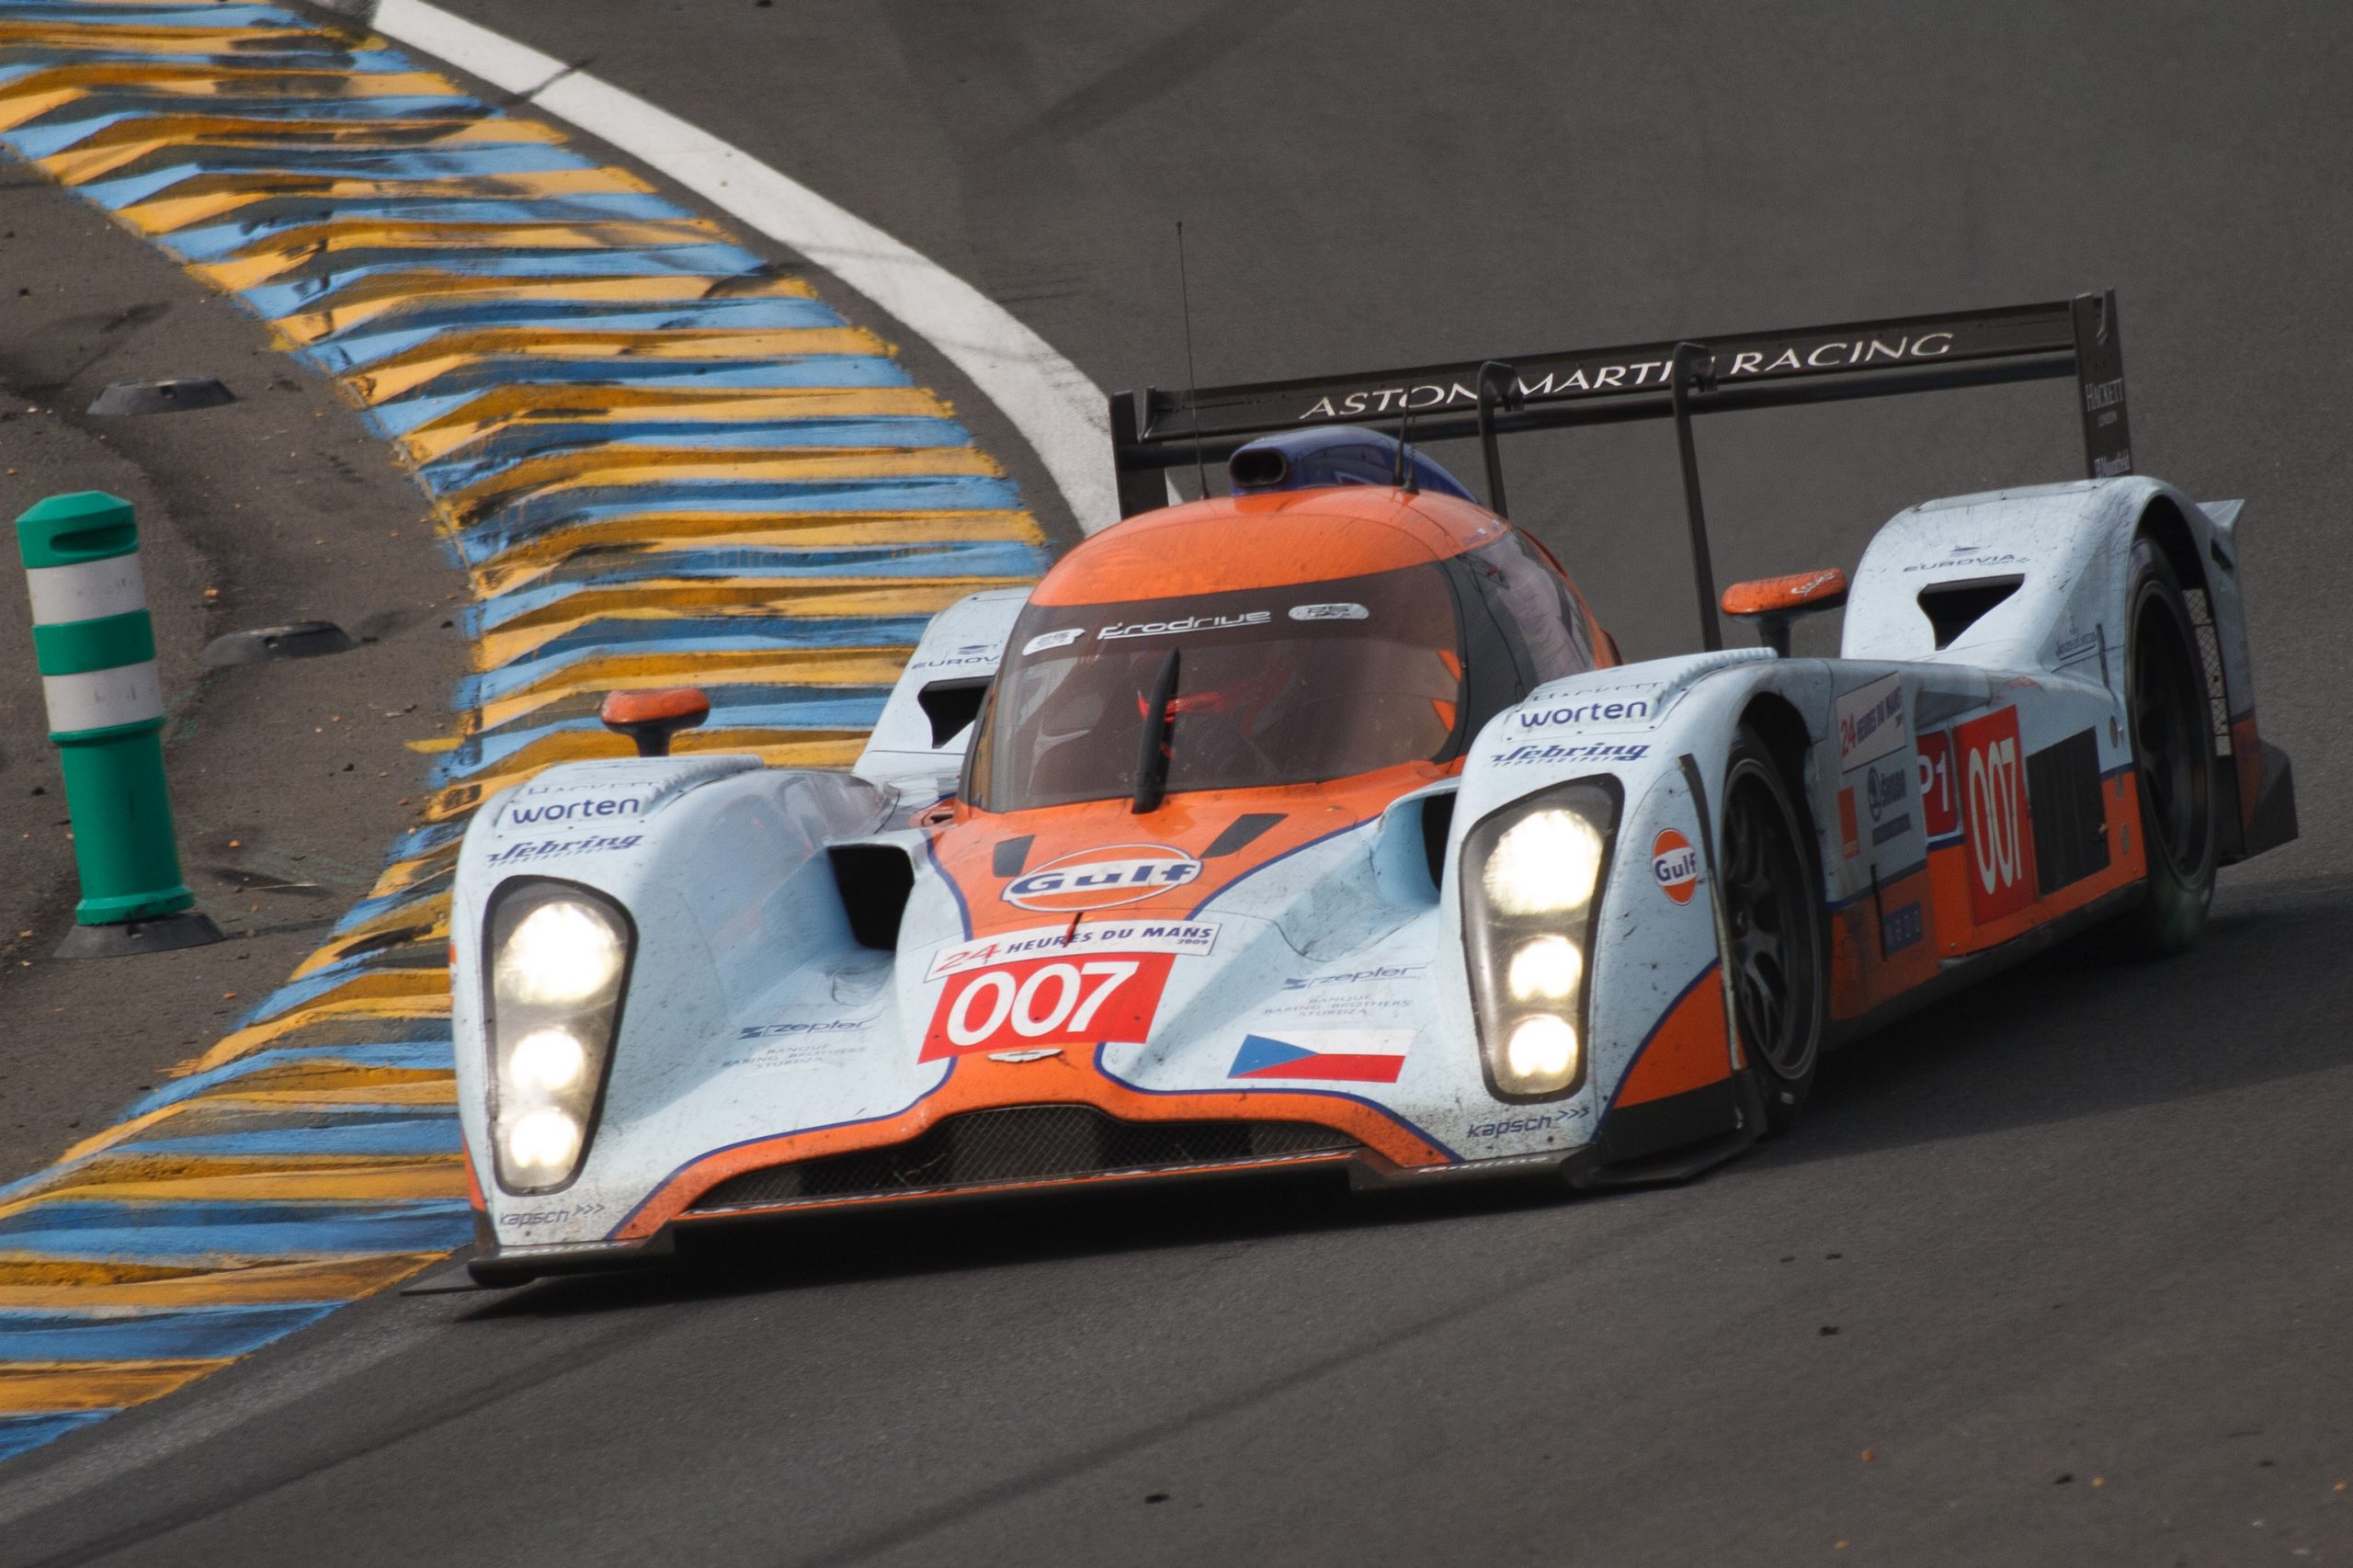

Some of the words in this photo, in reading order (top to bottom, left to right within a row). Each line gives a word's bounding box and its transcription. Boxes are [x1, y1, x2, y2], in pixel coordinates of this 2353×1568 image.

[1299, 381, 1479, 419] ASTON
[1730, 332, 1954, 375] RACING
[1520, 701, 1648, 728] worten
[1915, 750, 1949, 812] P1
[513, 798, 640, 824] worten
[1969, 737, 2022, 895] 007
[1011, 864, 1195, 894] Gulf
[1654, 852, 1696, 882] Gulf
[934, 943, 1001, 972] 24
[1006, 931, 1093, 954] HEURES
[1101, 927, 1135, 940] DU
[1142, 927, 1214, 938] MANS
[1176, 938, 1209, 947] 2009
[947, 961, 1140, 1046] 007
[1467, 1115, 1552, 1139] kapsch
[499, 1209, 570, 1228] kapsch
